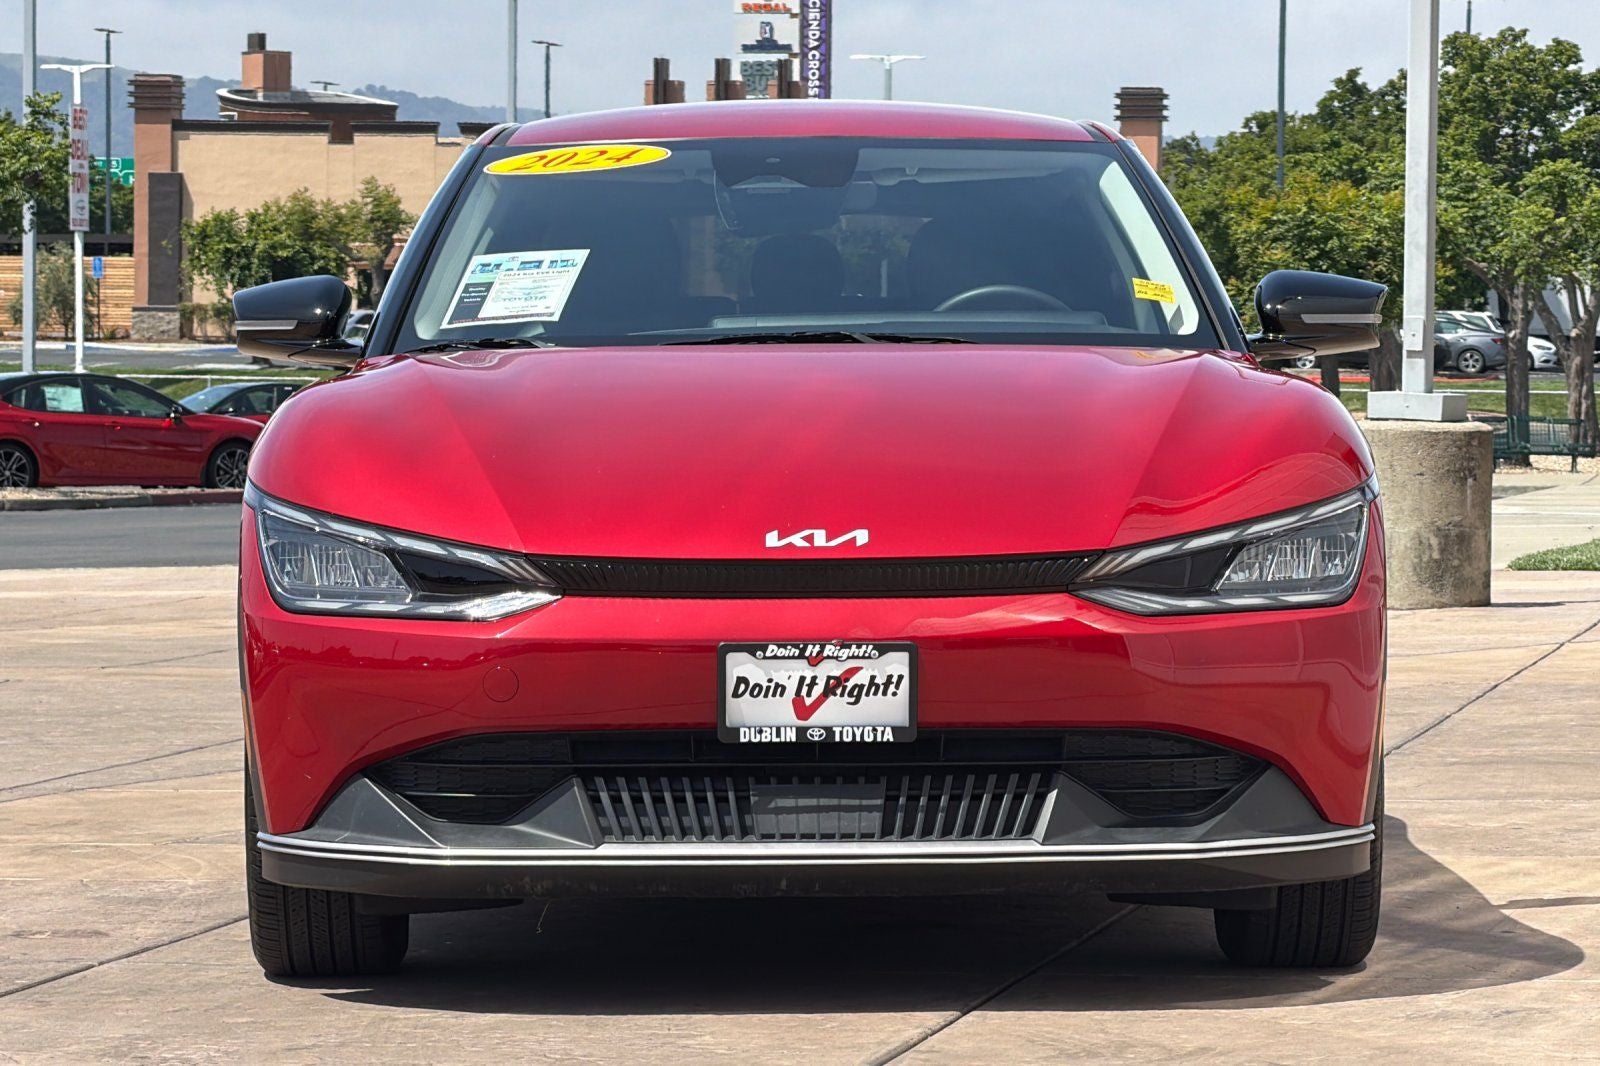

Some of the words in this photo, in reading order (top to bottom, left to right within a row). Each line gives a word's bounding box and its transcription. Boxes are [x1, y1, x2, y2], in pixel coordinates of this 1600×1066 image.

[741, 3, 792, 13] REGAL
[508, 149, 645, 171] 2024
[765, 529, 869, 548] KIA
[765, 644, 802, 658] Doin'
[805, 644, 821, 657] It
[821, 644, 874, 662] Right!
[731, 675, 792, 699] Doin'
[794, 674, 818, 698] It
[822, 673, 904, 706] Right!
[739, 726, 797, 743] DUBLIN
[832, 726, 894, 743] TOYOTA
